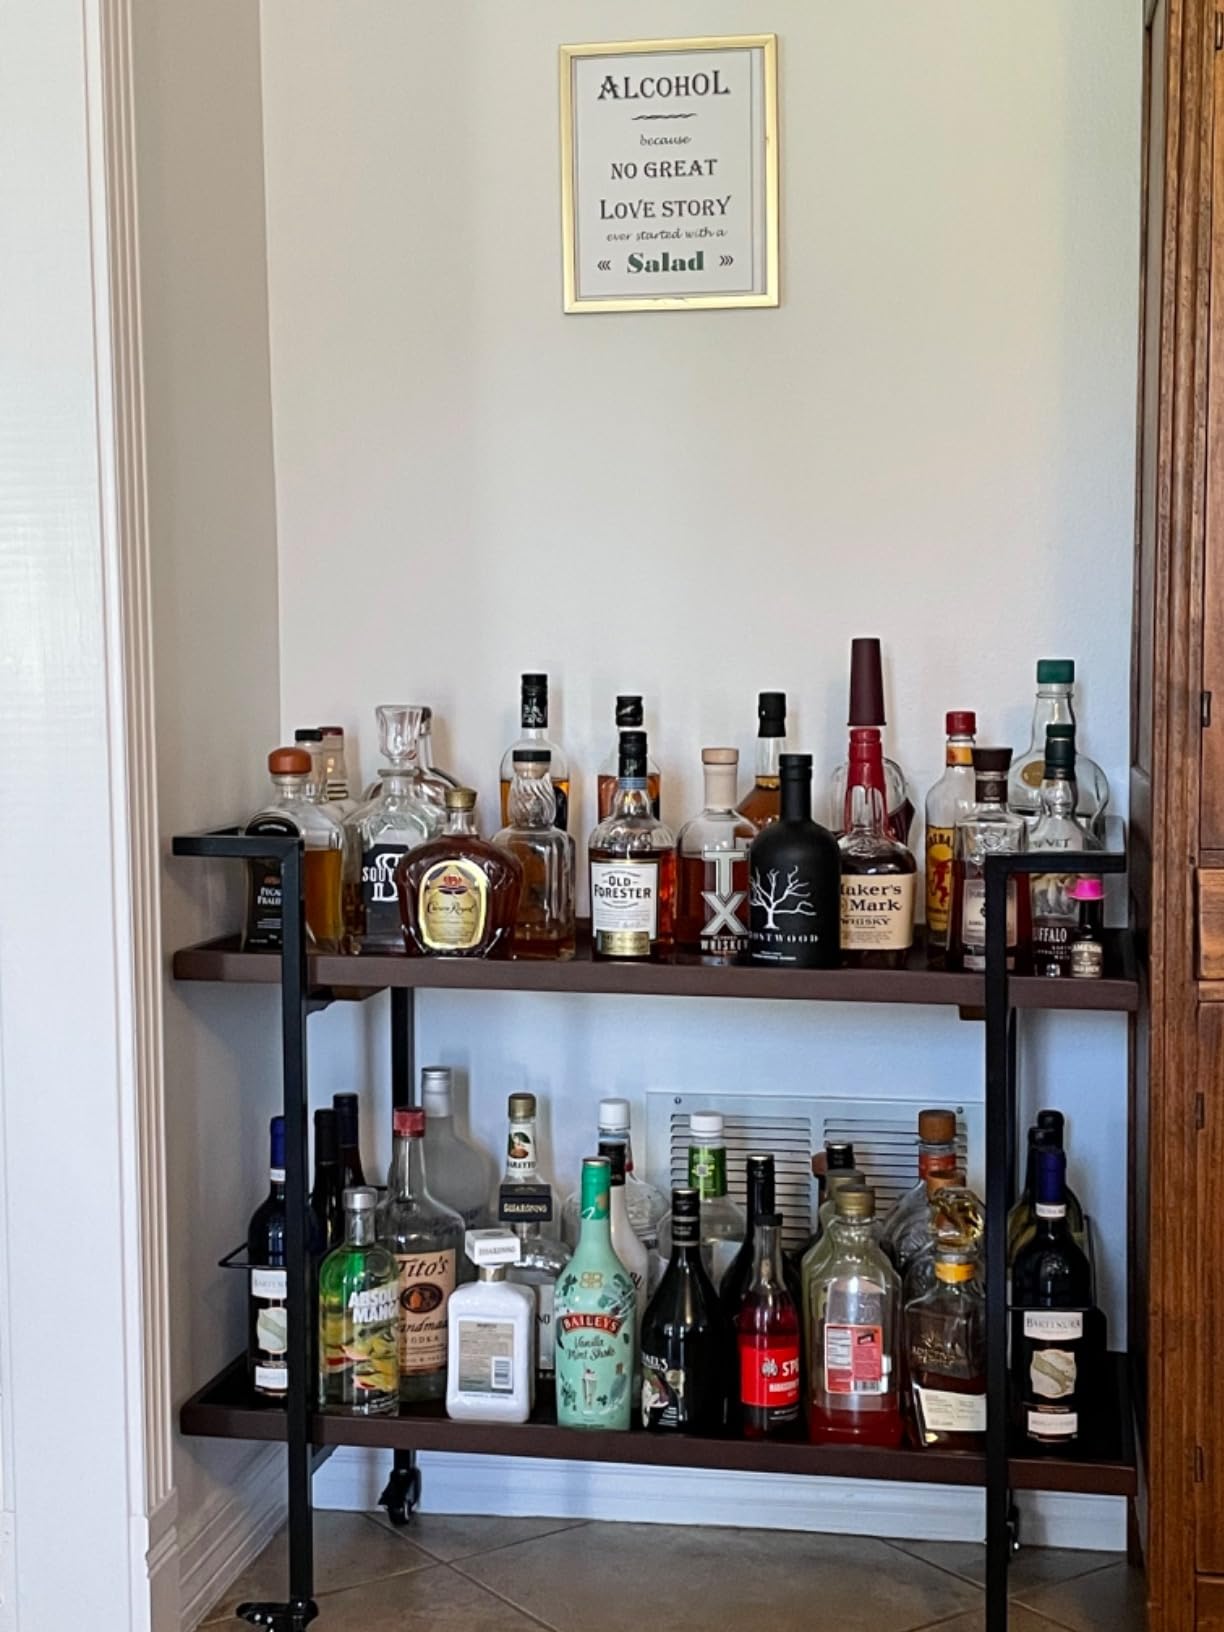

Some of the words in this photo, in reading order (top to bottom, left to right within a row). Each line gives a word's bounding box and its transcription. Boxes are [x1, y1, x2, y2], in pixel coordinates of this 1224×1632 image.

[597, 70, 731, 101] ALCOHOL
[639, 133, 692, 146] because
[611, 162, 638, 180] NO
[643, 158, 718, 179] GREAT
[600, 199, 656, 220] LOVE
[661, 194, 732, 217] STORY
[606, 232, 632, 242] ever
[636, 227, 682, 241] started
[685, 226, 714, 239] with
[716, 228, 728, 237] a
[626, 250, 704, 274] Salad
[608, 875, 631, 887] OLD
[594, 884, 652, 898] FORESTER
[850, 899, 903, 912] Mark
[398, 1256, 448, 1278] Tito's
[564, 1315, 619, 1332] BAILEYS
[574, 1335, 604, 1348] Vanilla
